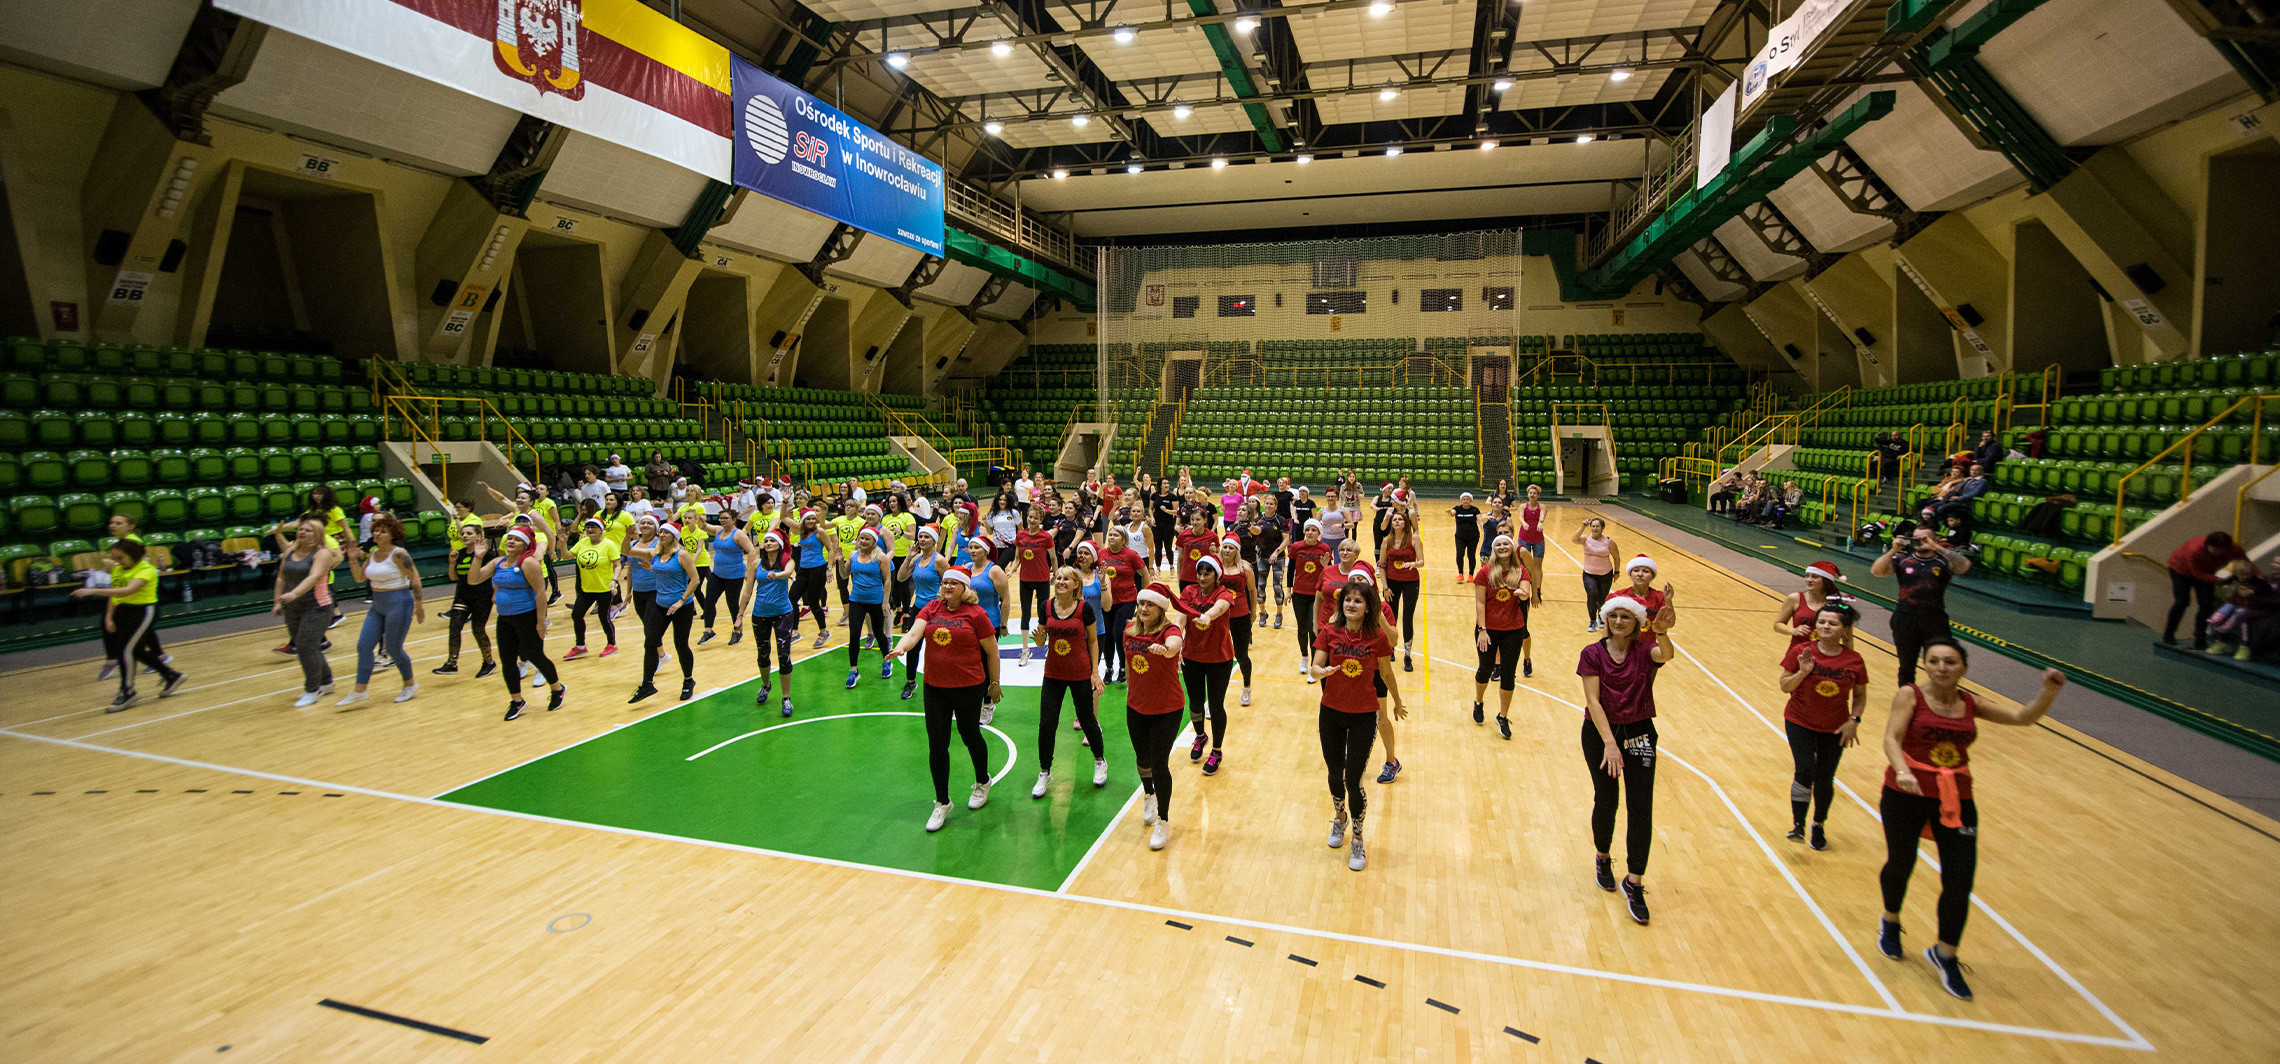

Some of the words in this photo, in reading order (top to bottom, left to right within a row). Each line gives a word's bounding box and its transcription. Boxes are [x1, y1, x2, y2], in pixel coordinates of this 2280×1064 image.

[795, 95, 850, 140] Ośrodek
[853, 125, 890, 160] Sportu
[892, 147, 896, 163] i
[898, 149, 941, 188] Rekreacji
[793, 130, 828, 169] SiR
[306, 158, 330, 172] BB
[841, 149, 853, 166] w
[856, 152, 927, 200] Inowrocławiu
[557, 219, 573, 230] BC
[717, 258, 728, 267] CA
[113, 288, 143, 301] BB
[461, 292, 479, 307] B
[444, 323, 464, 332] BC
[634, 343, 647, 352] CA
[1333, 642, 1372, 659] ZUMBA
